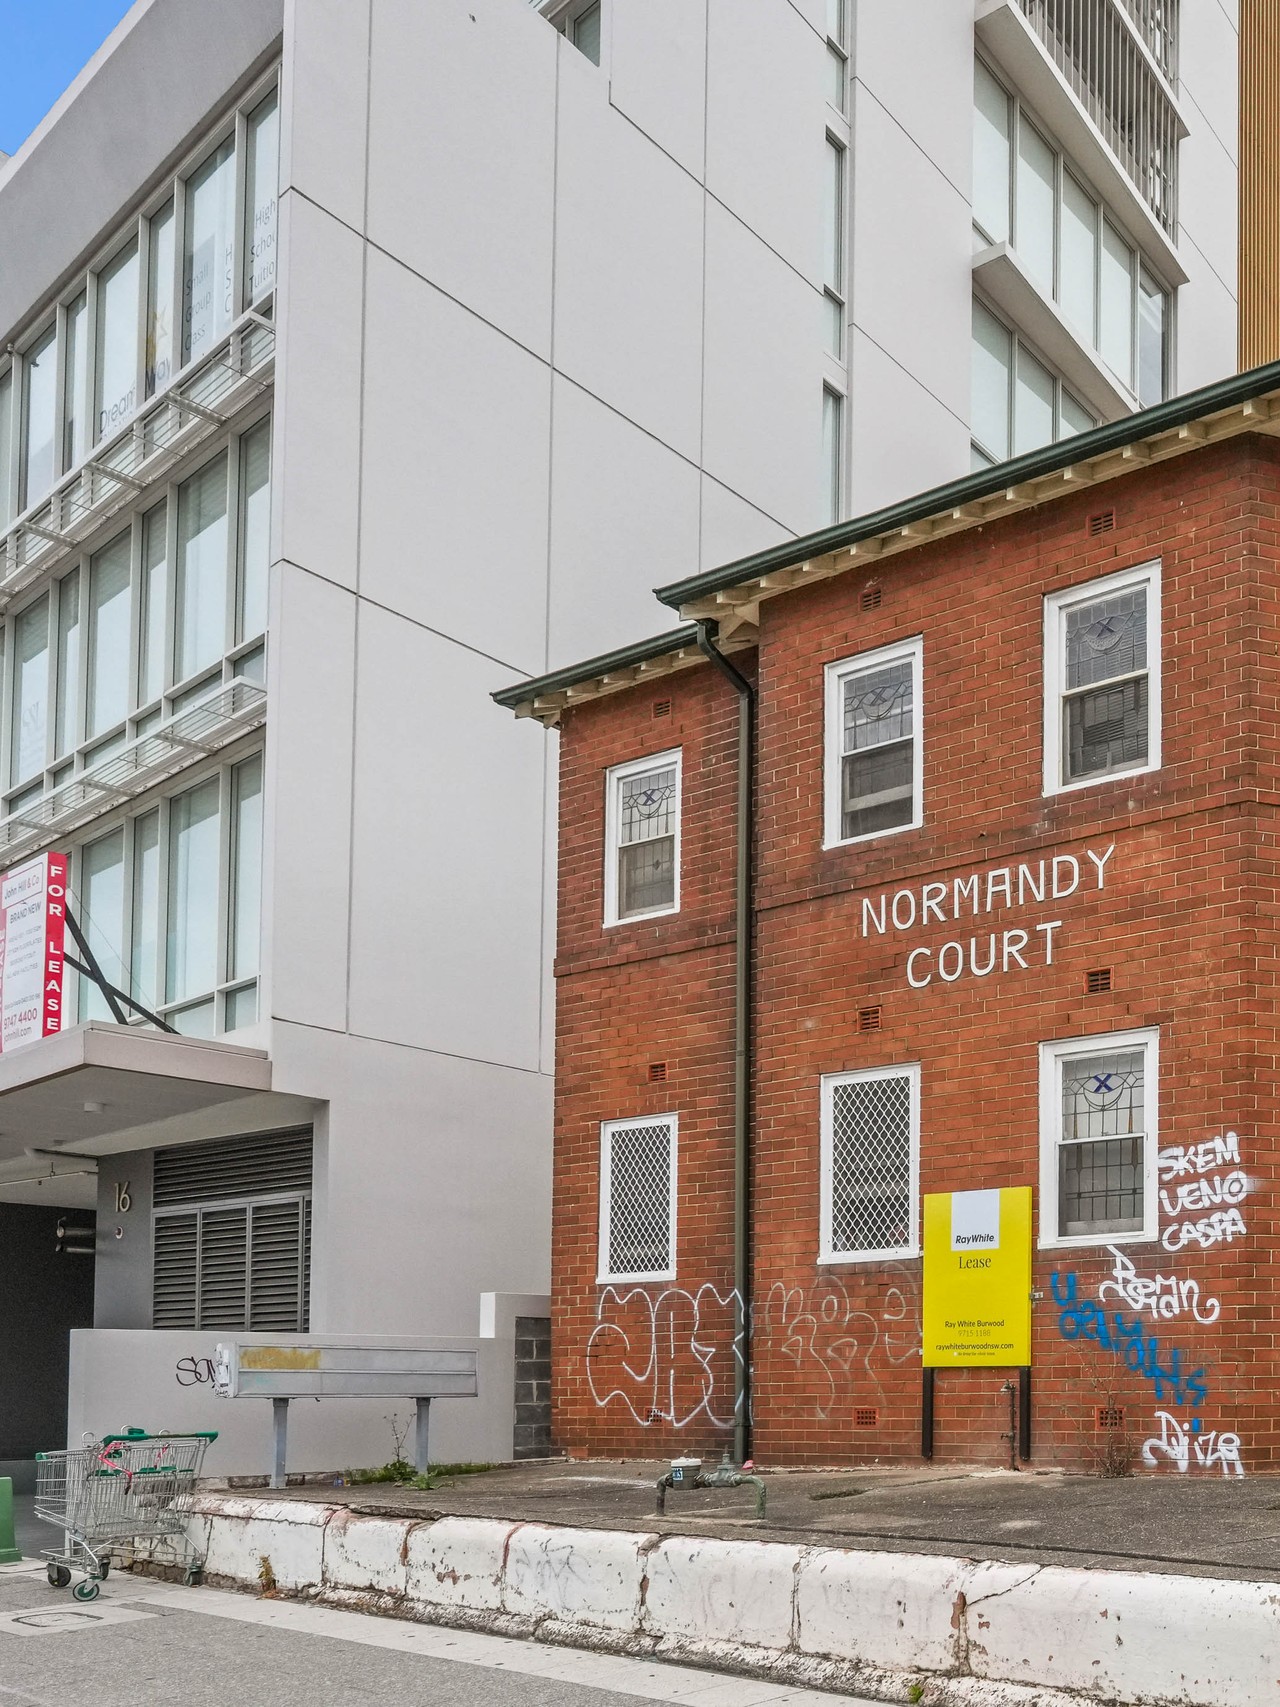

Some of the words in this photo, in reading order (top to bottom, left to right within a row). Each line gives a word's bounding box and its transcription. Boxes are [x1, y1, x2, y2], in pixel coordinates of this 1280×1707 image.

[48, 865, 64, 917] FOR
[862, 844, 1116, 938] NORMANDY
[906, 920, 1063, 989] COURT
[45, 941, 61, 1031] LEASE
[18, 1008, 38, 1024] 4400
[114, 1181, 132, 1213] 16
[958, 1255, 992, 1270] Lease
[944, 1320, 956, 1329] Ray
[957, 1320, 975, 1328] White
[977, 1319, 1005, 1328] Burwood
